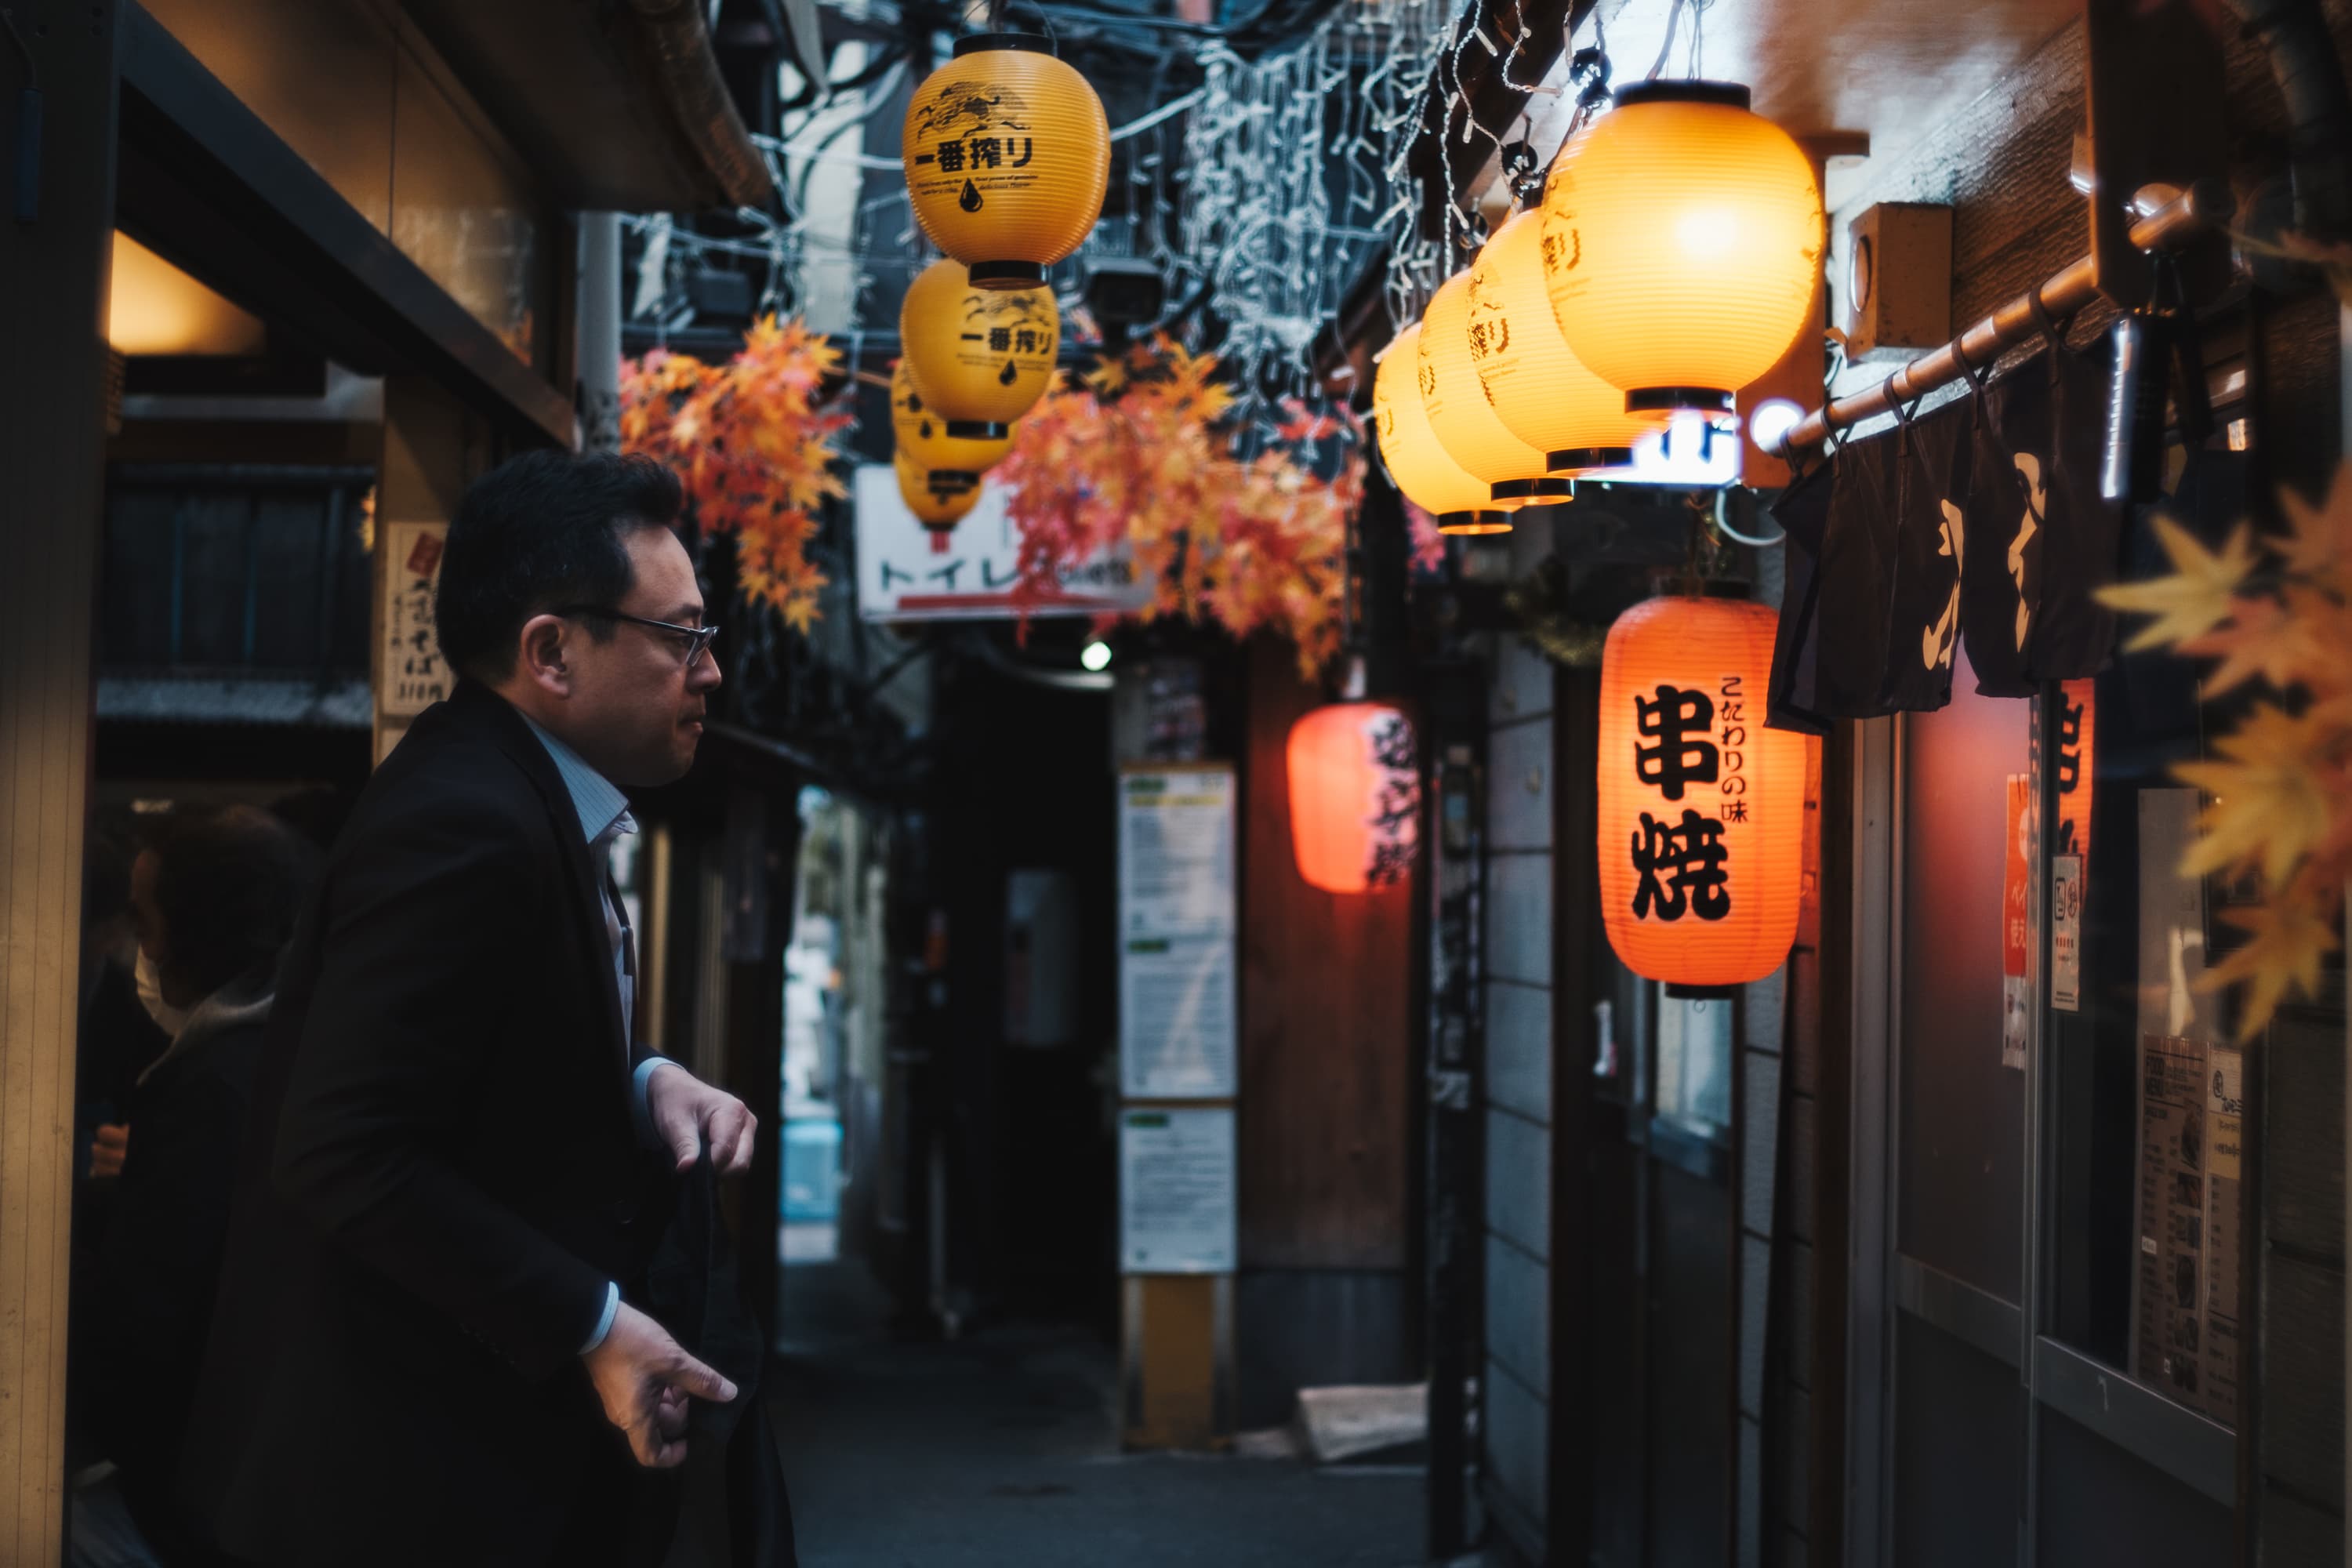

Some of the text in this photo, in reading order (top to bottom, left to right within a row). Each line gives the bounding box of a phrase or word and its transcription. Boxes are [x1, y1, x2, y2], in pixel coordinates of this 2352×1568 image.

[915, 137, 1033, 172] 一番搾り
[960, 327, 1053, 355] 一番搾り
[881, 557, 1022, 592] トイレ
[1720, 676, 1748, 824] こだわりの味
[1632, 684, 1731, 922] 串焼
[2146, 1054, 2165, 1076] FOOD
